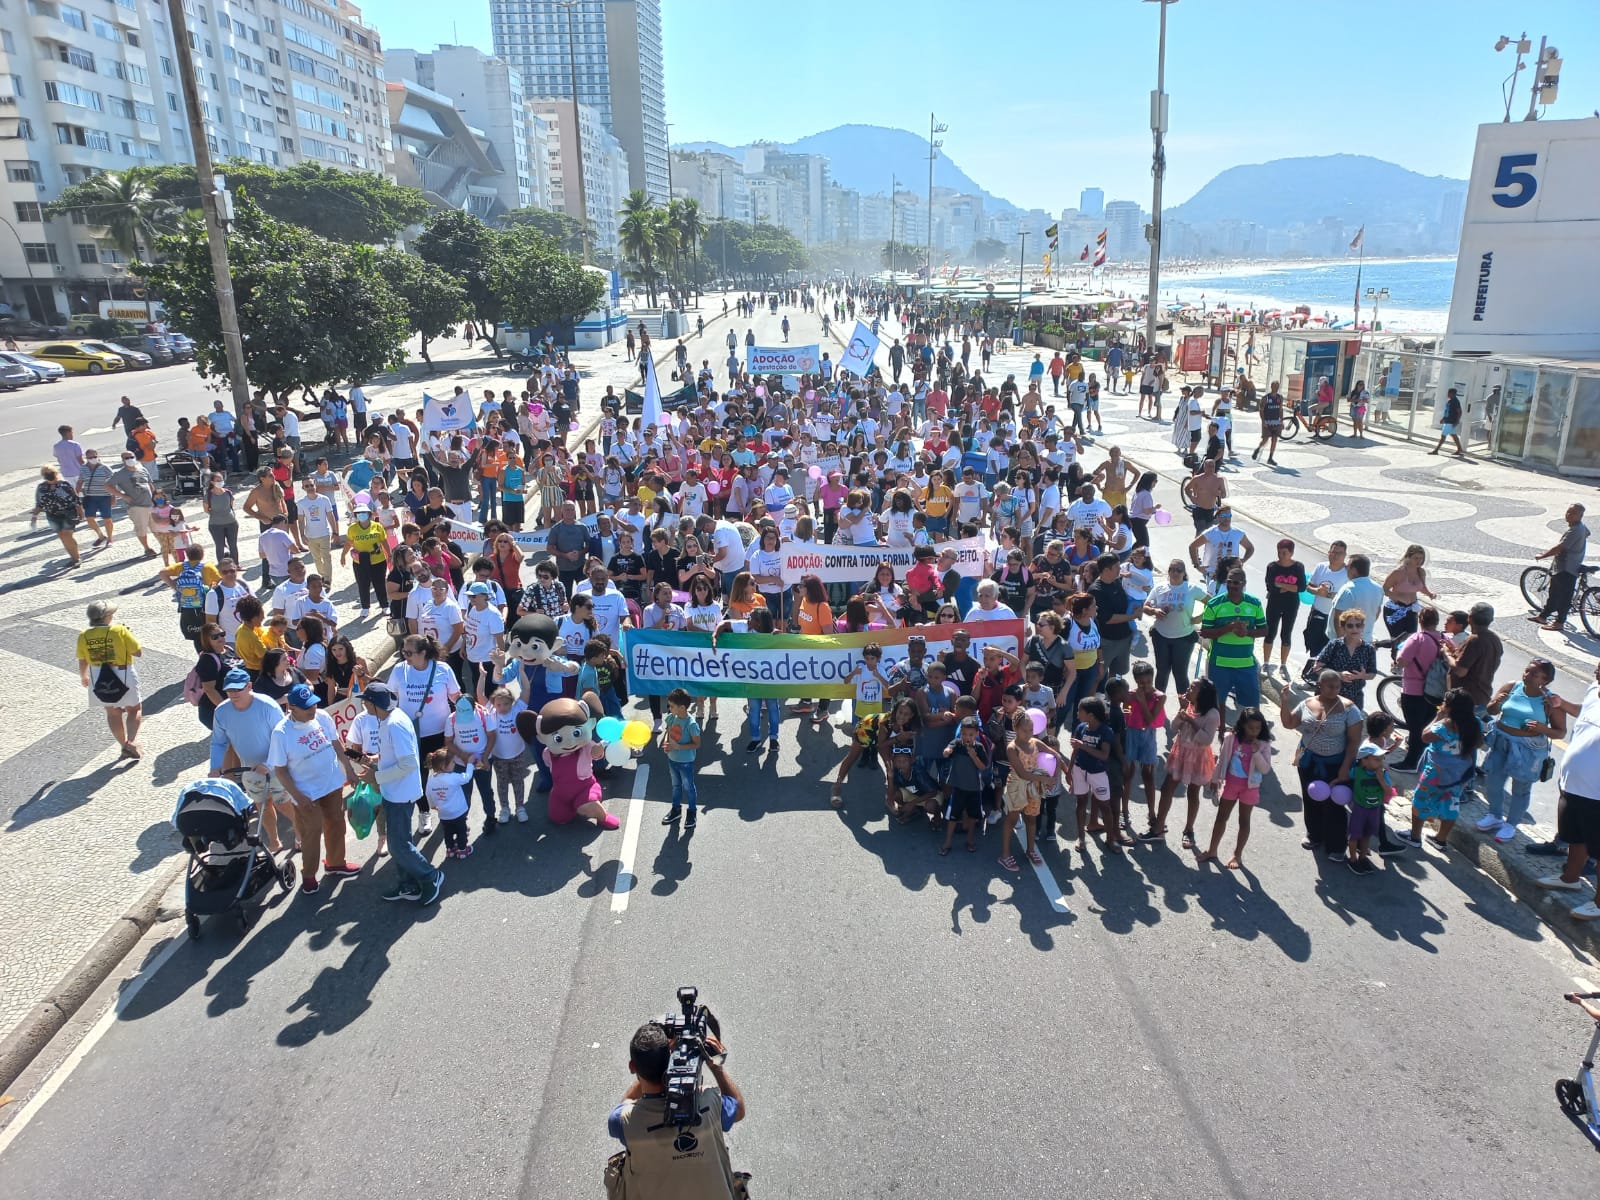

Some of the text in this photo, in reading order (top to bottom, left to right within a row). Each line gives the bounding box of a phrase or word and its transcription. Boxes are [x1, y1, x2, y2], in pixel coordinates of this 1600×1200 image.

[1492, 153, 1538, 208] 5
[1472, 251, 1494, 322] PREFEITURA
[752, 354, 795, 365] ADOÇÃO
[786, 552, 823, 572] ADOÇÃO:
[824, 554, 858, 568] CONTRA
[859, 553, 880, 568] TODA
[882, 553, 910, 566] FORMA
